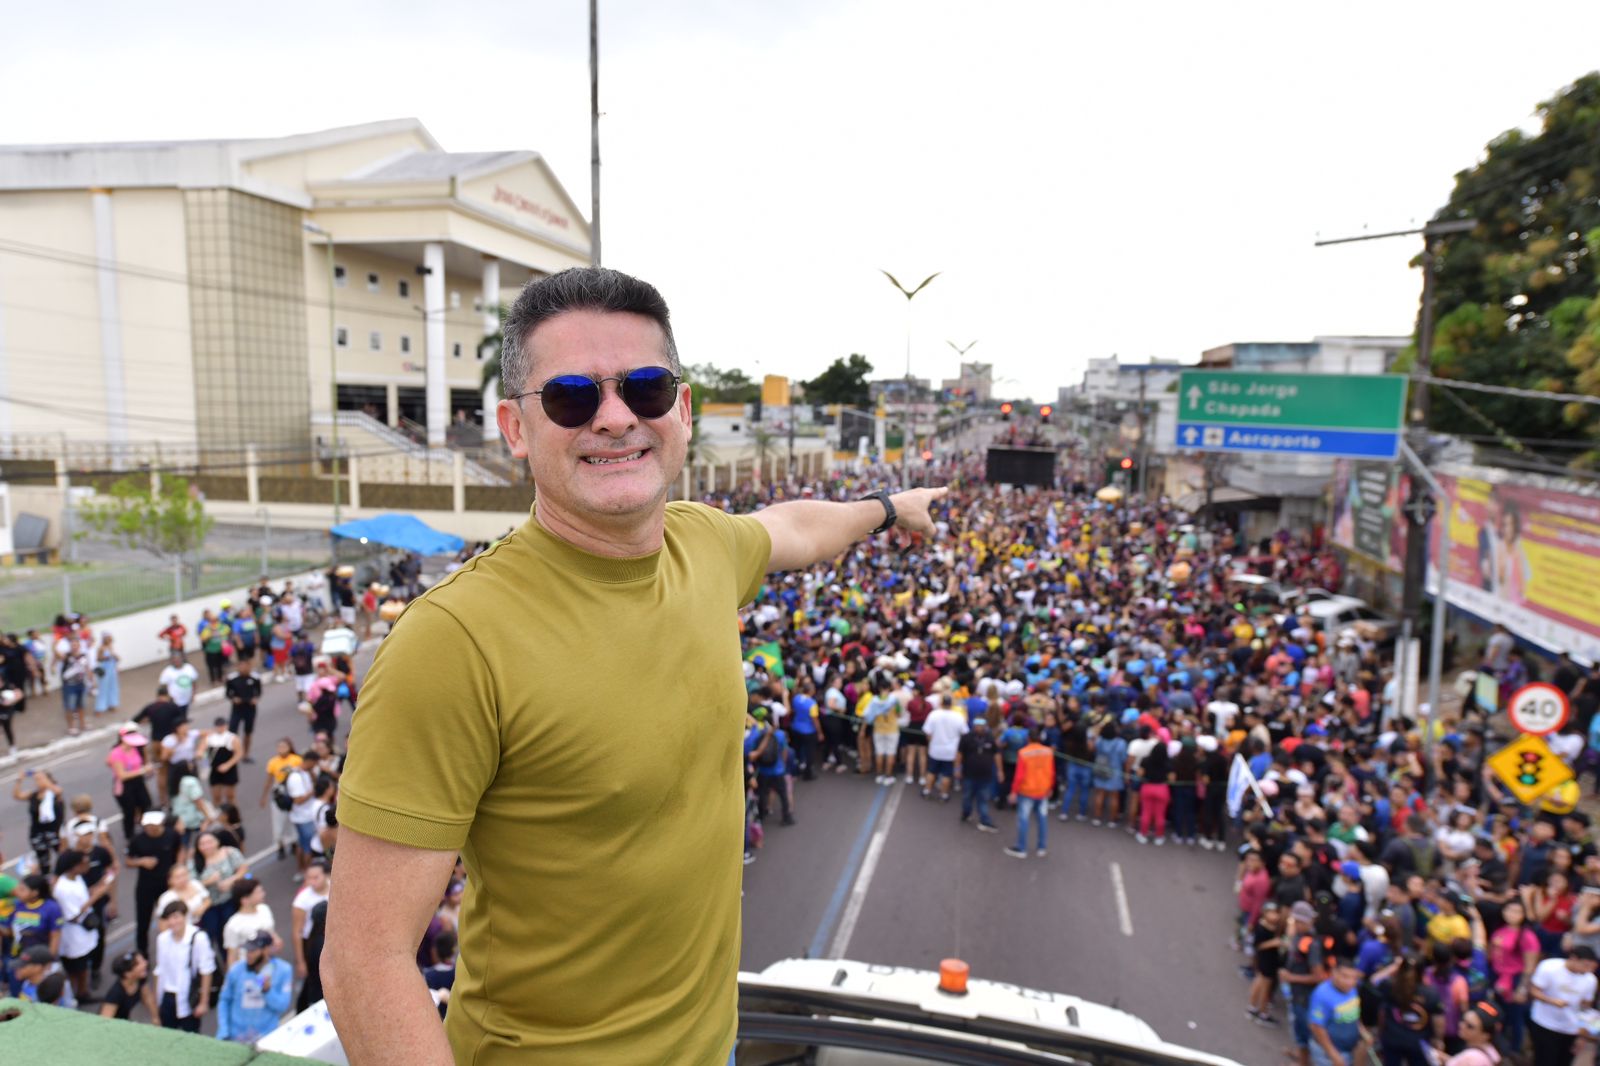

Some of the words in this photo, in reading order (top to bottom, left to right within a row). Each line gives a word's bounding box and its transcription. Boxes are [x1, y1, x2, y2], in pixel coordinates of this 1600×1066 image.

[1207, 380, 1240, 395] São
[1247, 383, 1298, 398] Jorge
[1204, 401, 1281, 417] Chapada
[1229, 431, 1321, 449] Aeroporto
[1520, 699, 1558, 718] 40
